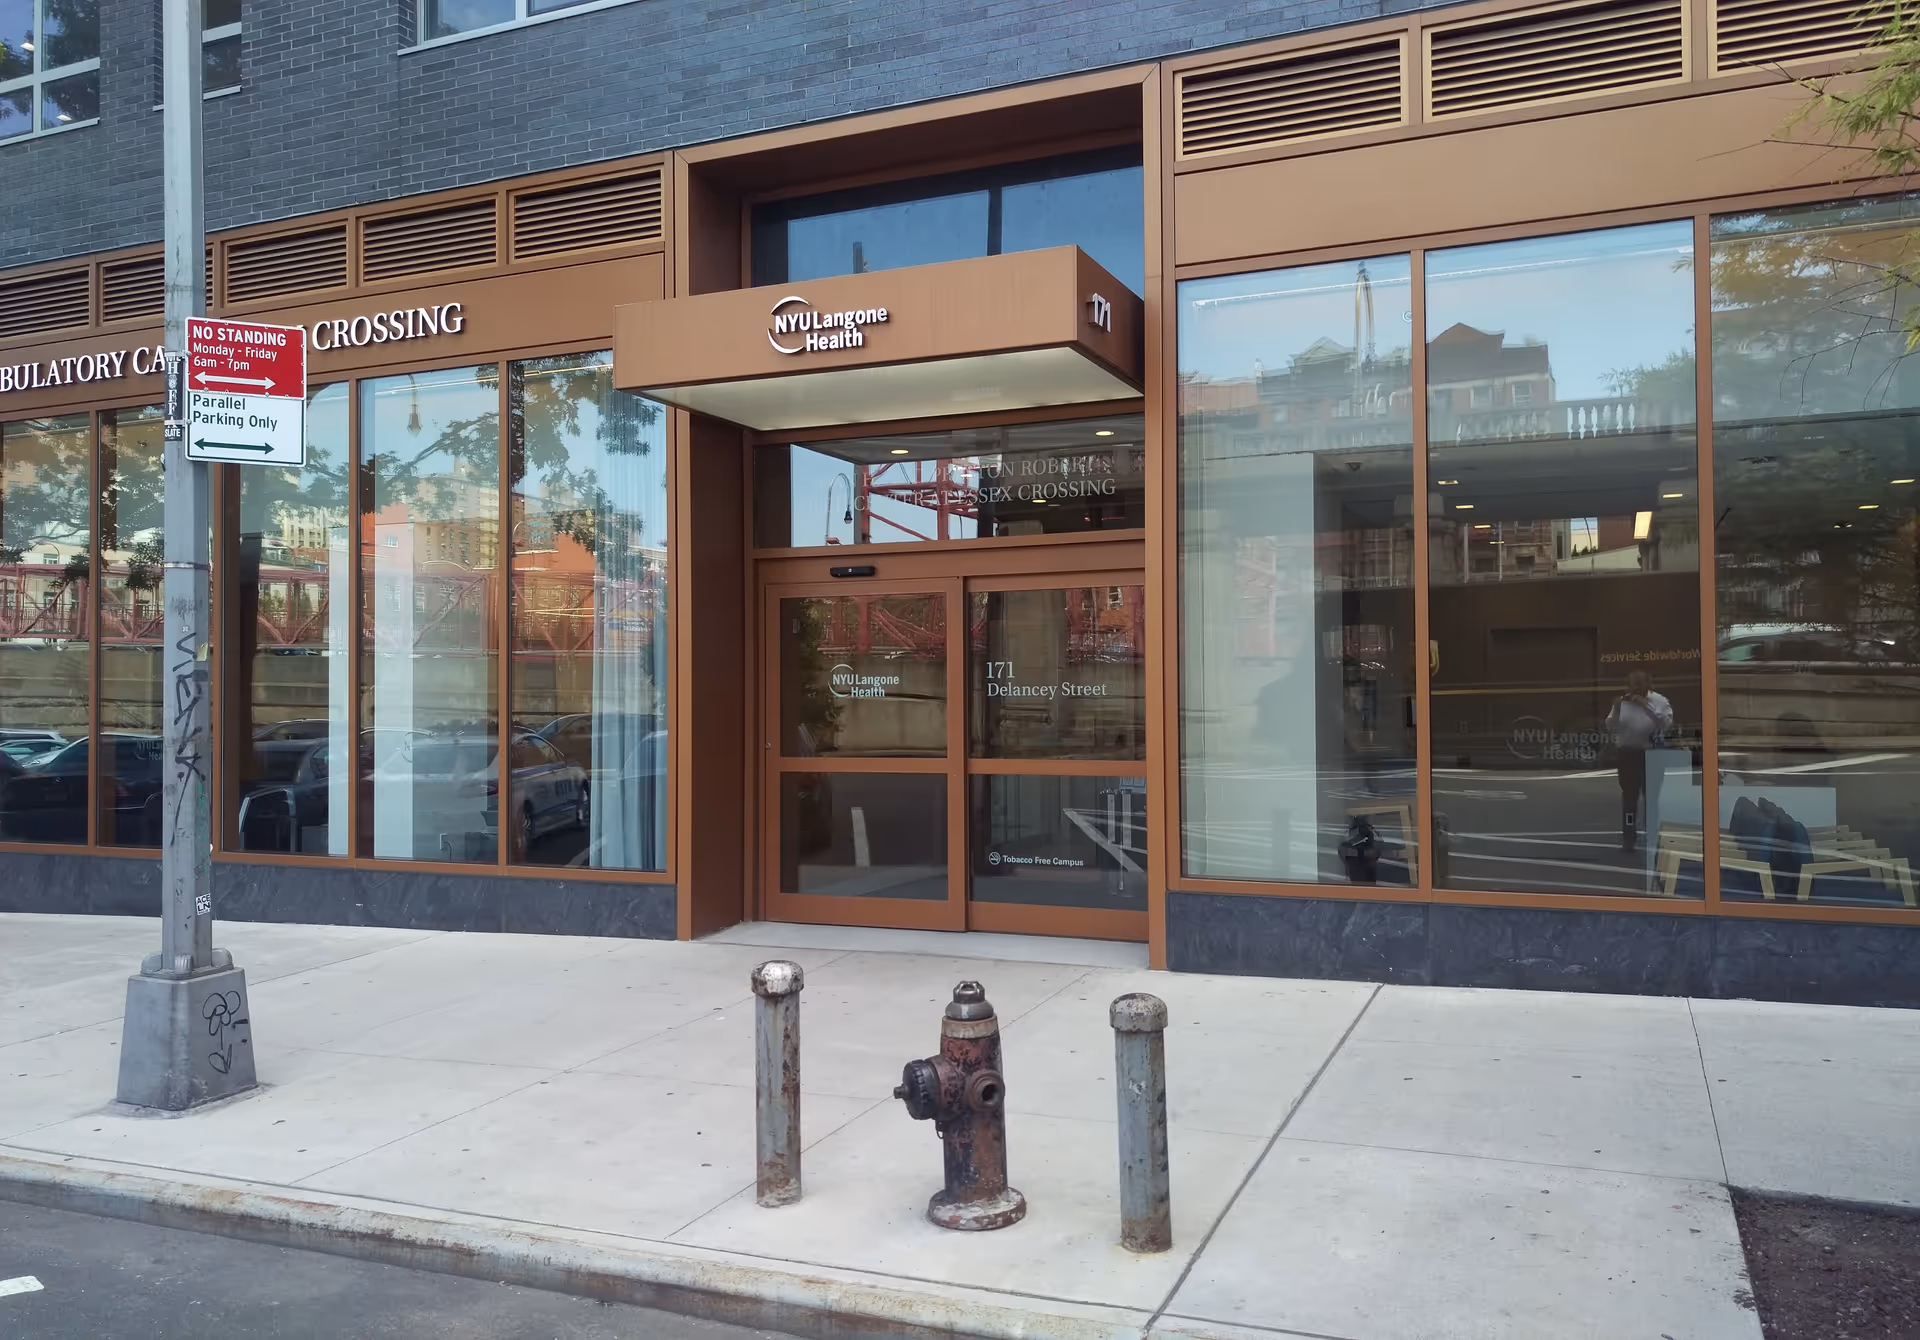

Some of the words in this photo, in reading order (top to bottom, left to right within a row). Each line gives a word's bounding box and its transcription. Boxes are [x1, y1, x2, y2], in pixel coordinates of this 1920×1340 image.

[775, 312, 811, 334] NYU
[813, 307, 888, 329] Langone
[1092, 292, 1111, 333] 171
[193, 325, 213, 340] NO
[217, 328, 287, 347] STANDING
[805, 328, 863, 352] Health
[0, 350, 127, 393] BULATORY
[311, 302, 464, 351] CROSSING
[193, 342, 235, 358] Monday
[245, 347, 278, 362] Friday
[193, 356, 217, 368] 6am
[227, 358, 250, 372] 7pm
[193, 394, 246, 411] Parallel
[193, 410, 244, 429] Parking
[249, 415, 278, 432] Only
[164, 428, 181, 438] SLATE
[933, 462, 1015, 483] PRTON
[957, 485, 1013, 505] ESSEX
[1017, 478, 1117, 501] CROSSING
[985, 661, 1015, 679] 171
[832, 673, 854, 685] NYU
[855, 674, 900, 687] Langone
[850, 686, 885, 698] Health
[987, 682, 1058, 700] Delancey
[1061, 681, 1107, 697] Street
[1513, 728, 1547, 743] NYU
[1543, 745, 1597, 760] Health
[1002, 854, 1033, 865] Tobacco
[1034, 856, 1051, 865] Free
[1052, 857, 1084, 868] Campus
